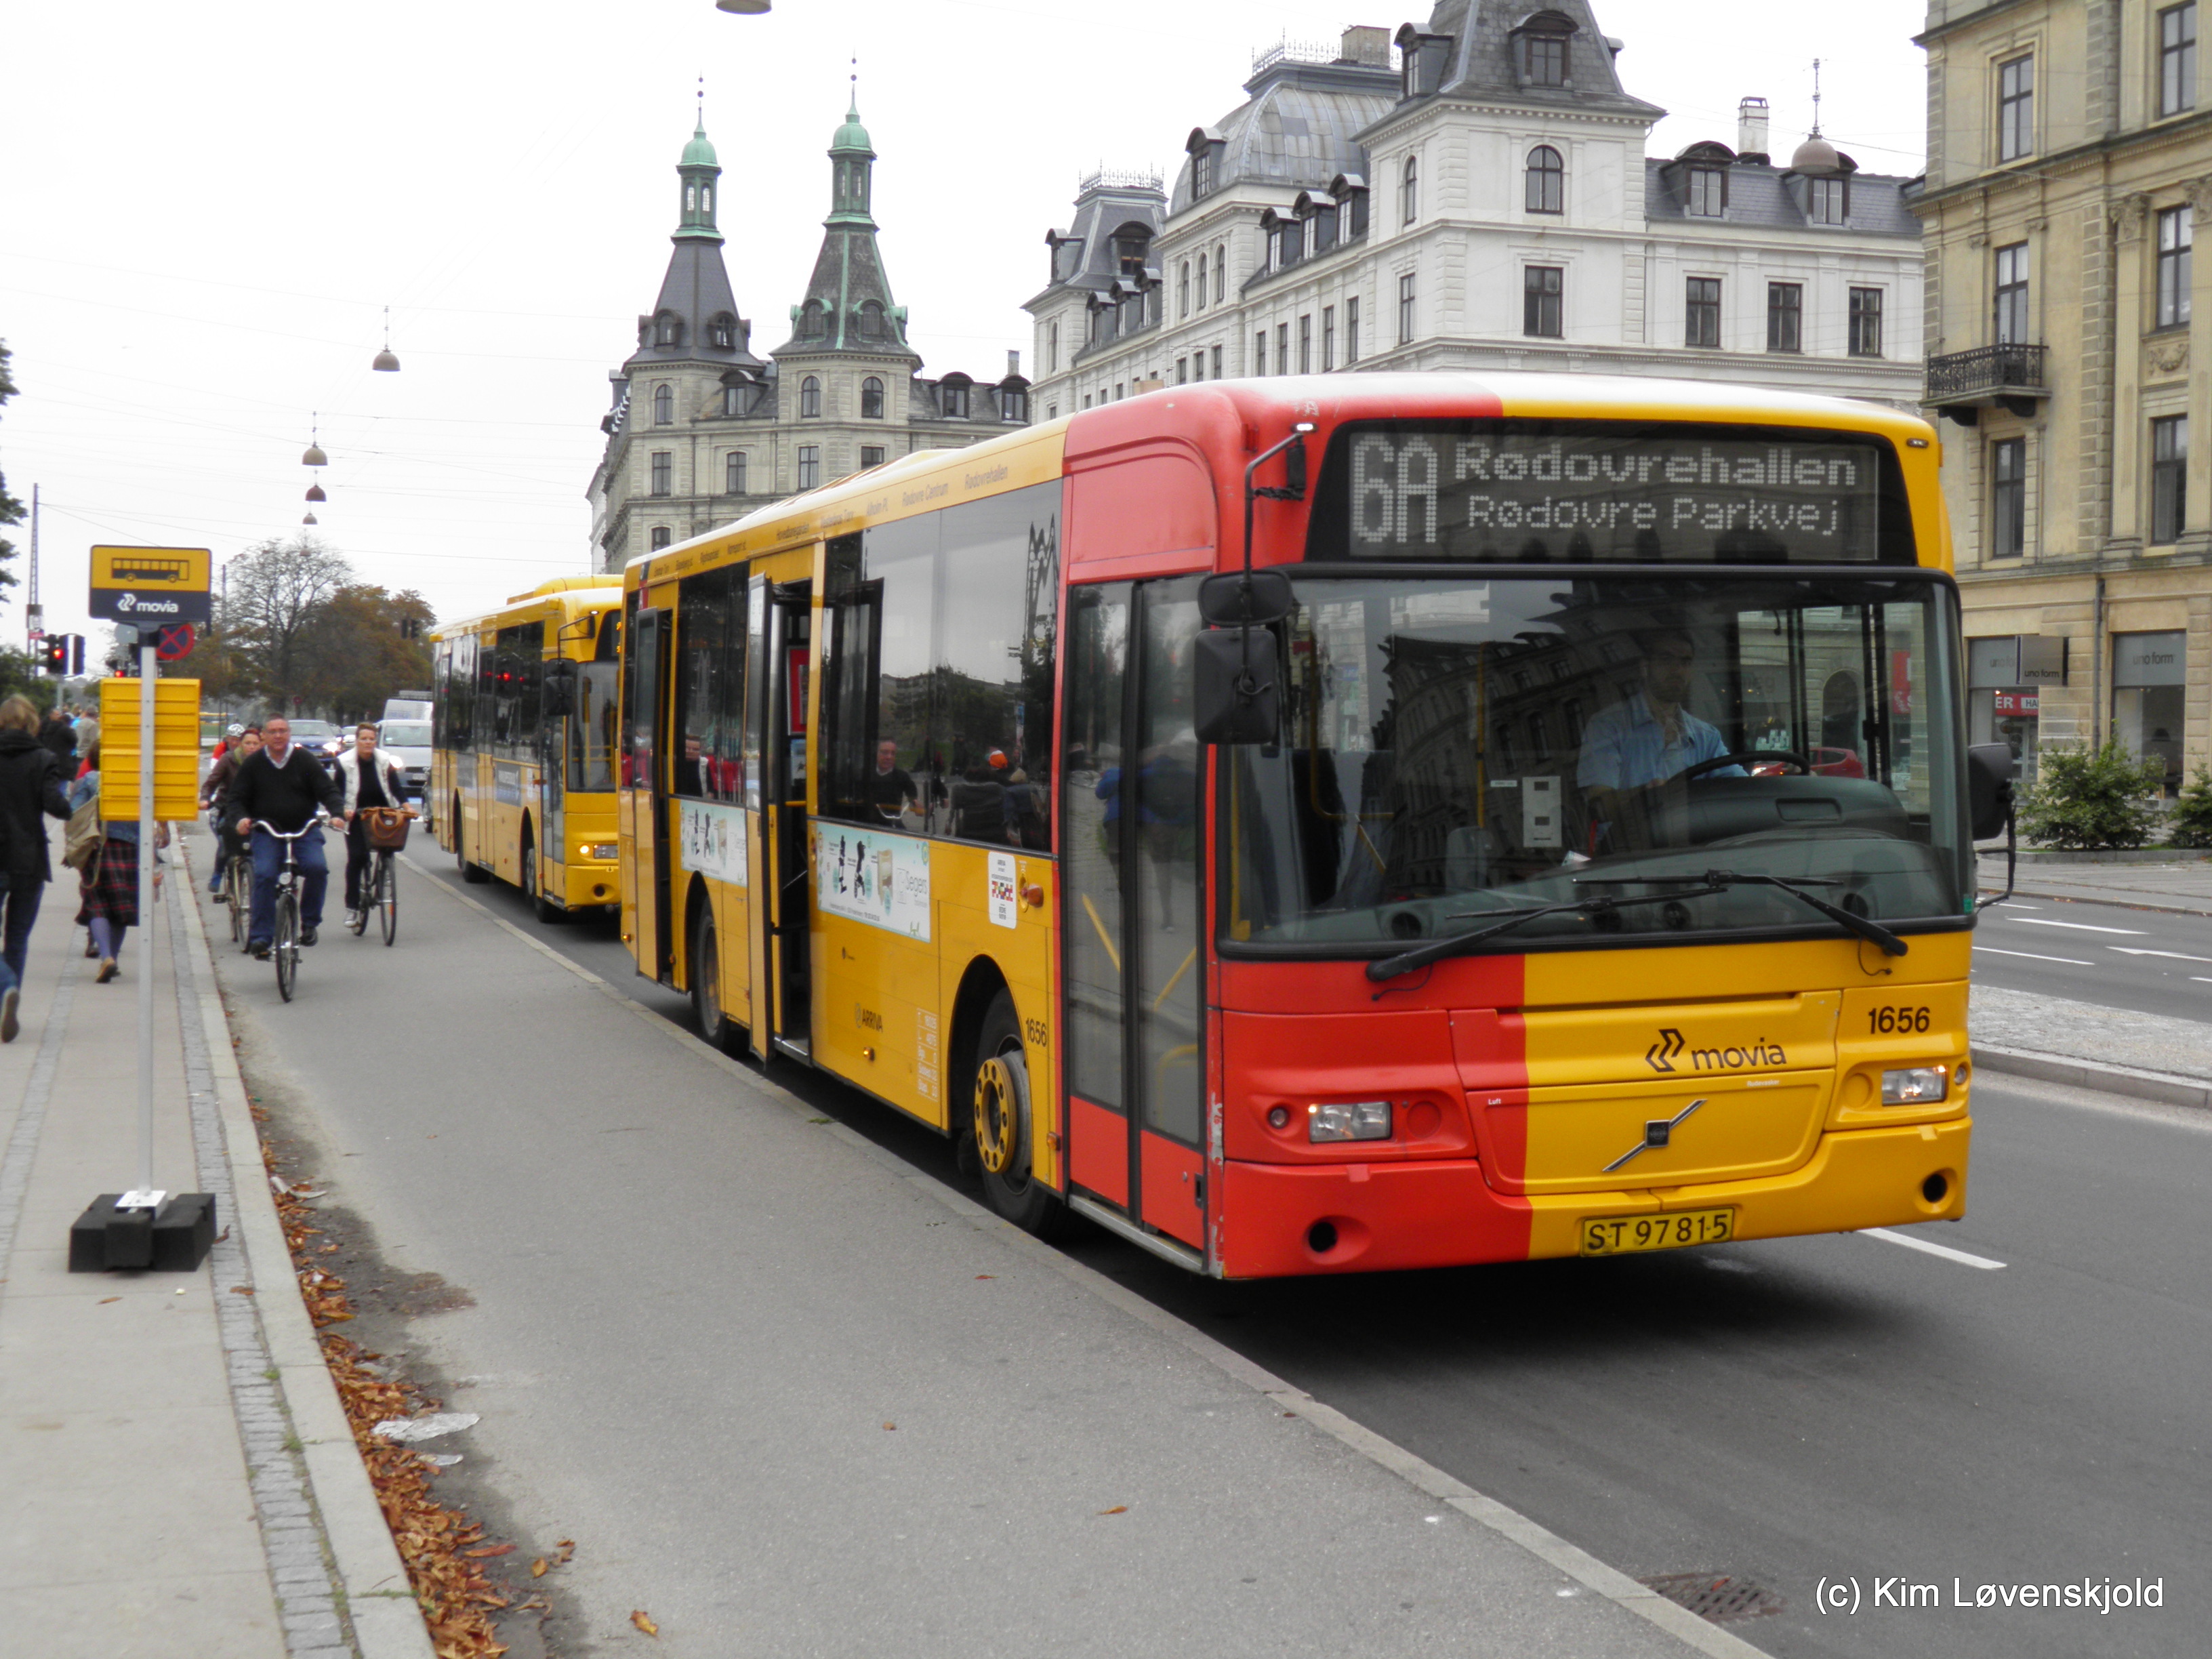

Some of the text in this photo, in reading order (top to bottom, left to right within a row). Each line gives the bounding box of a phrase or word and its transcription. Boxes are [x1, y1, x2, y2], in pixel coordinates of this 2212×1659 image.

[1355, 434, 1856, 543] 6A Rødovrehallen
[1469, 495, 1839, 535] Rødovre Parkvej
[137, 600, 178, 613] movia
[2150, 652, 2174, 663] form
[2024, 668, 2060, 678] uno form
[1025, 1018, 1047, 1047] 1656
[1868, 1006, 1930, 1035] 1656
[1692, 1037, 1786, 1071] movia
